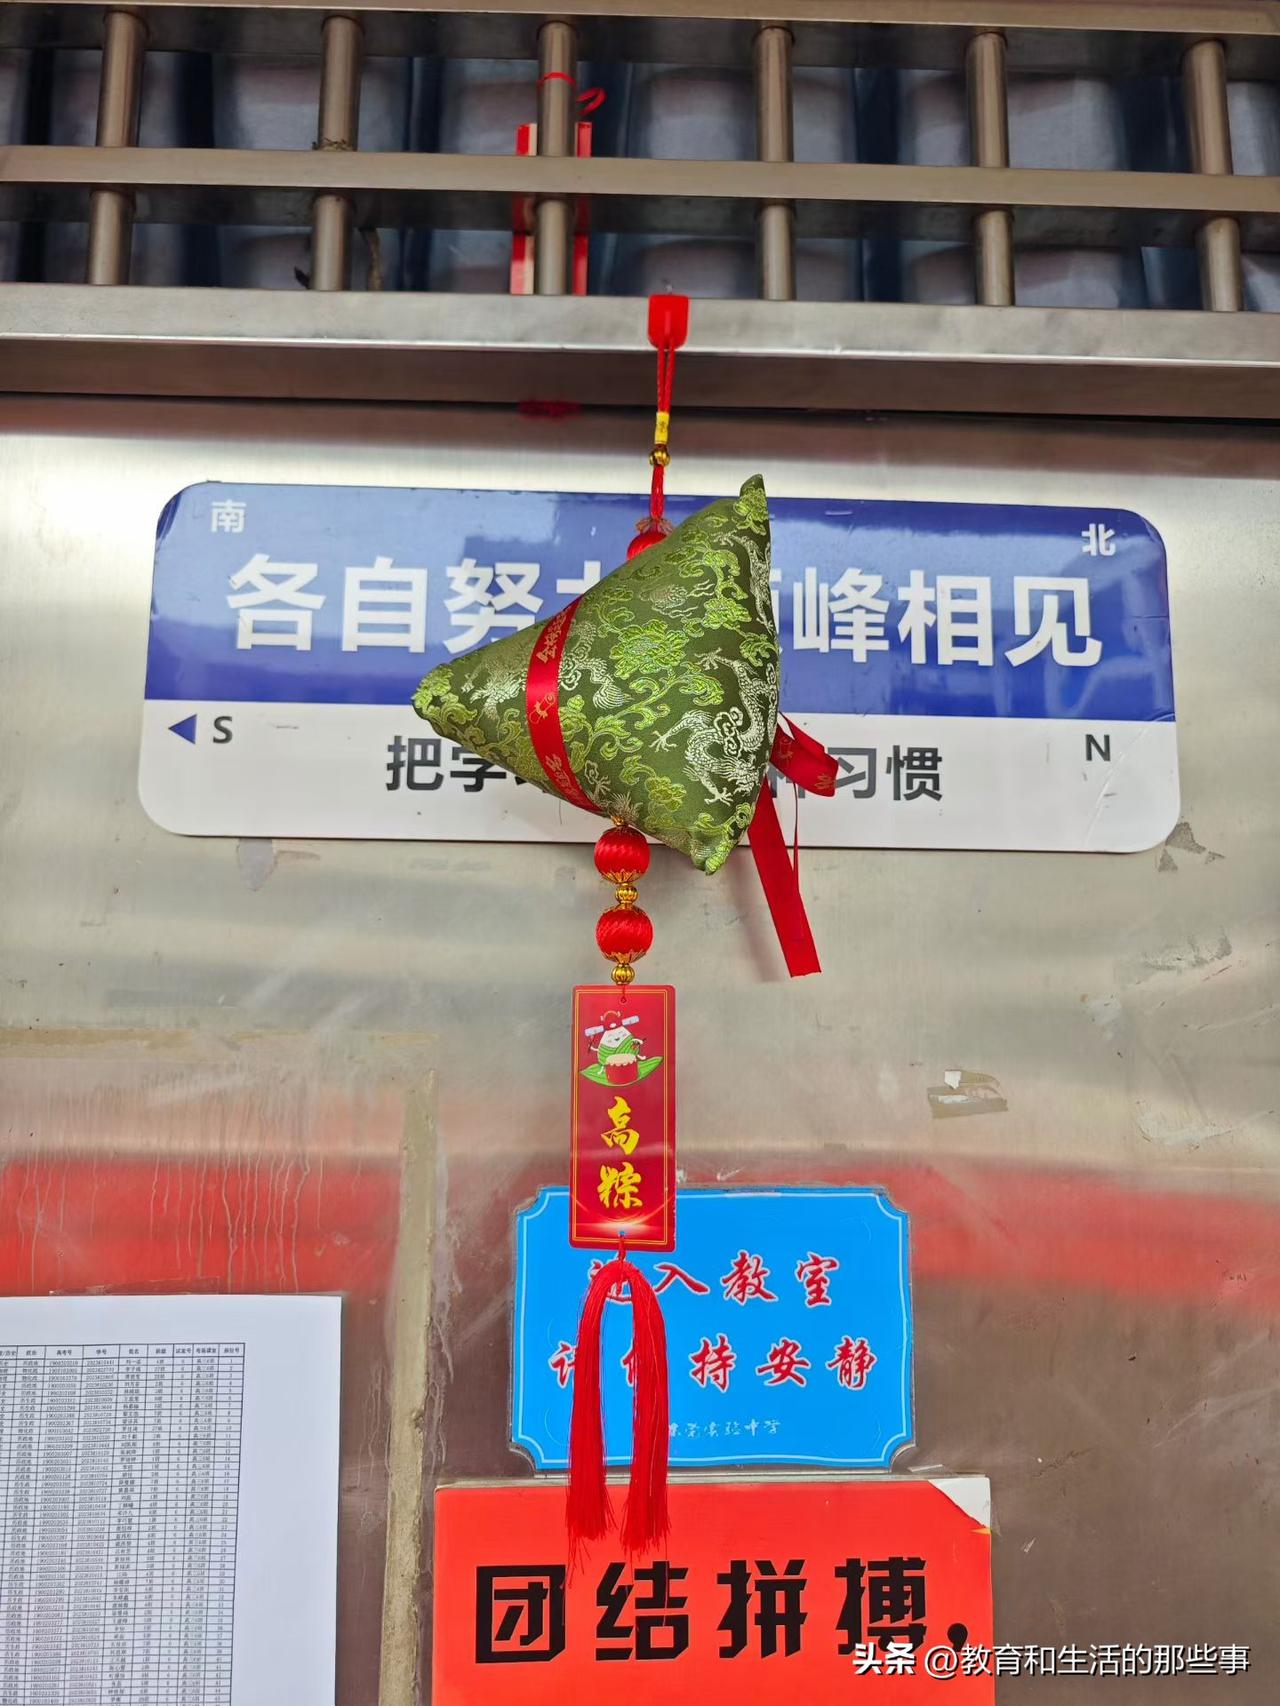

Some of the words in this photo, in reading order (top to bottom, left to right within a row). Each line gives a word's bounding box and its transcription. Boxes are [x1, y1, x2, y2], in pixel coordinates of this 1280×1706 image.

[211, 500, 246, 532] 南
[1081, 523, 1116, 557] 北
[212, 716, 233, 744] S
[1086, 734, 1111, 762] N
[597, 1096, 643, 1209] 高粽
